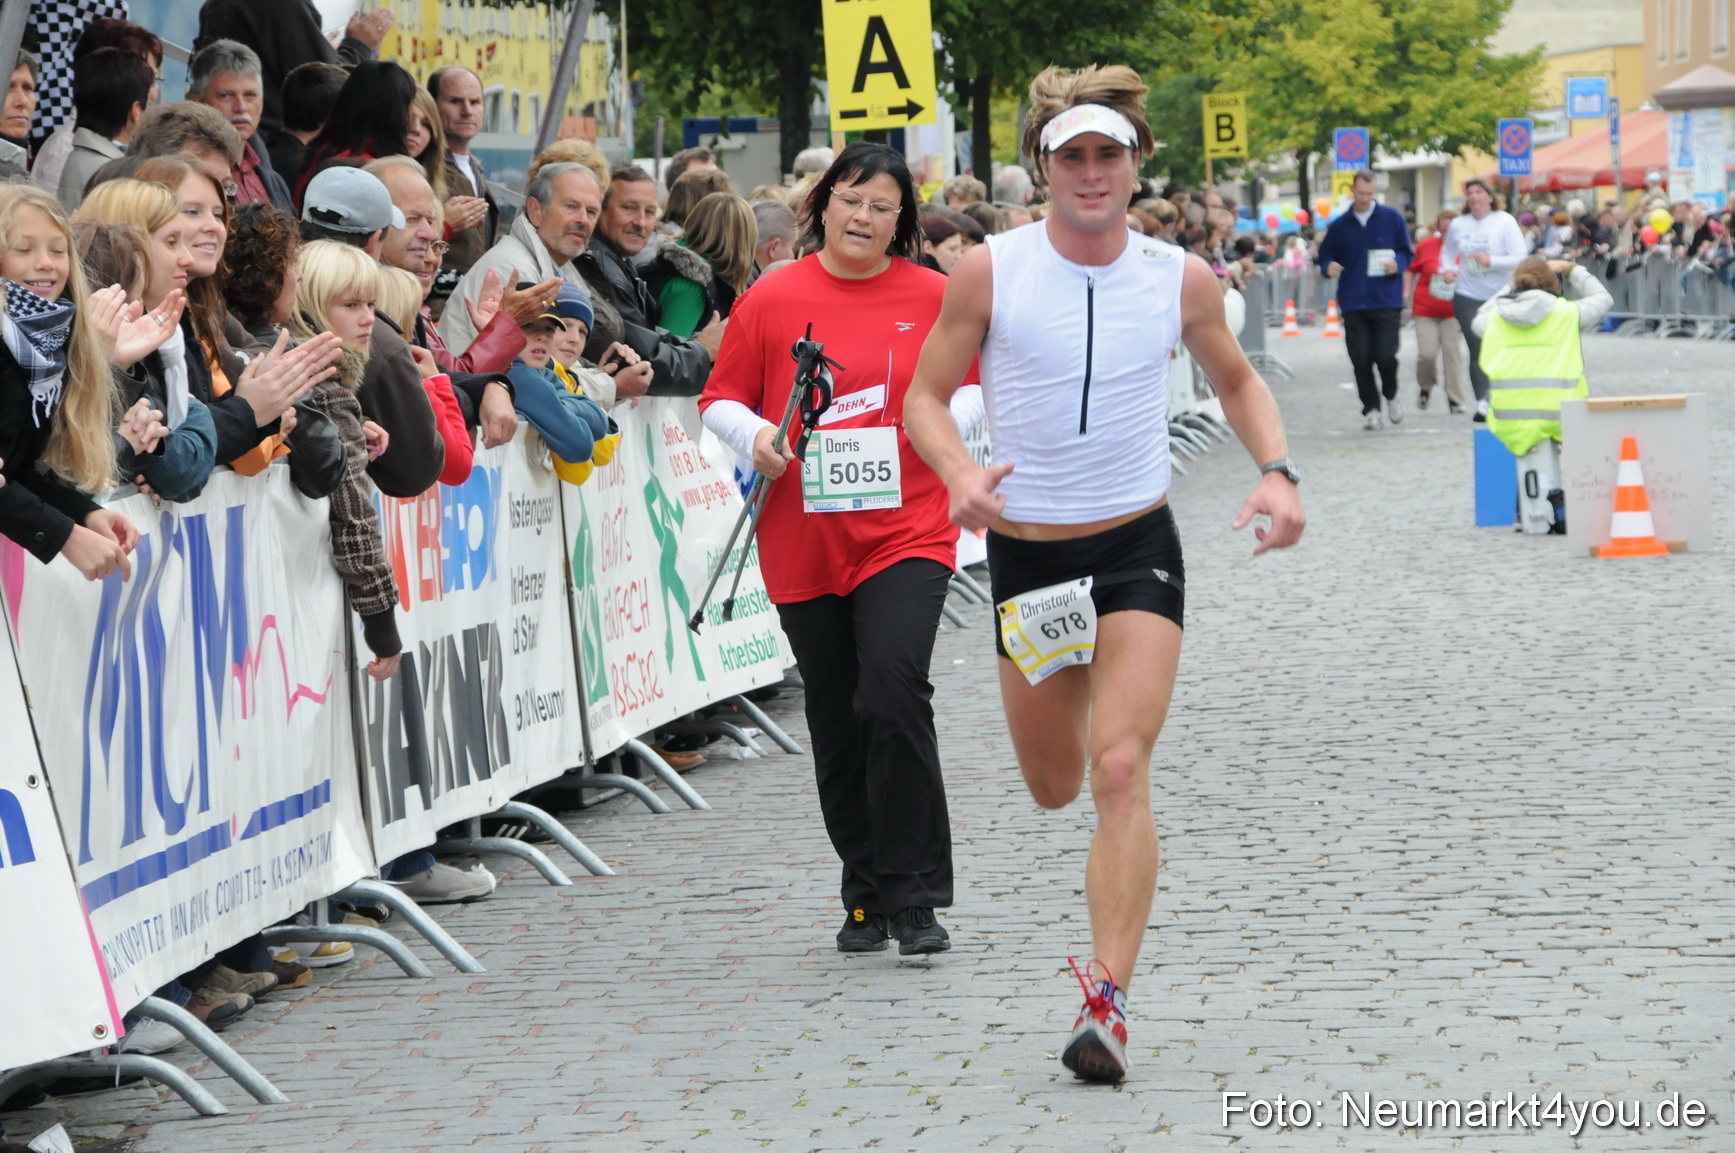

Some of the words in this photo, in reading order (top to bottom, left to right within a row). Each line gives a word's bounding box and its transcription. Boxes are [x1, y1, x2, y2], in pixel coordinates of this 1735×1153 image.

[851, 15, 911, 93] A
[1208, 95, 1241, 108] Block
[1216, 113, 1236, 143] B
[1502, 158, 1530, 172] TAXI
[837, 396, 867, 414] DEHN
[825, 437, 860, 454] Doris
[804, 463, 811, 475] S
[829, 460, 892, 485] 5055
[863, 495, 900, 505] PFLEIDERER
[1020, 588, 1077, 620] Christoph
[1040, 611, 1087, 640] 678
[1009, 636, 1018, 649] A
[611, 650, 664, 717] BESSER
[853, 908, 865, 922] S
